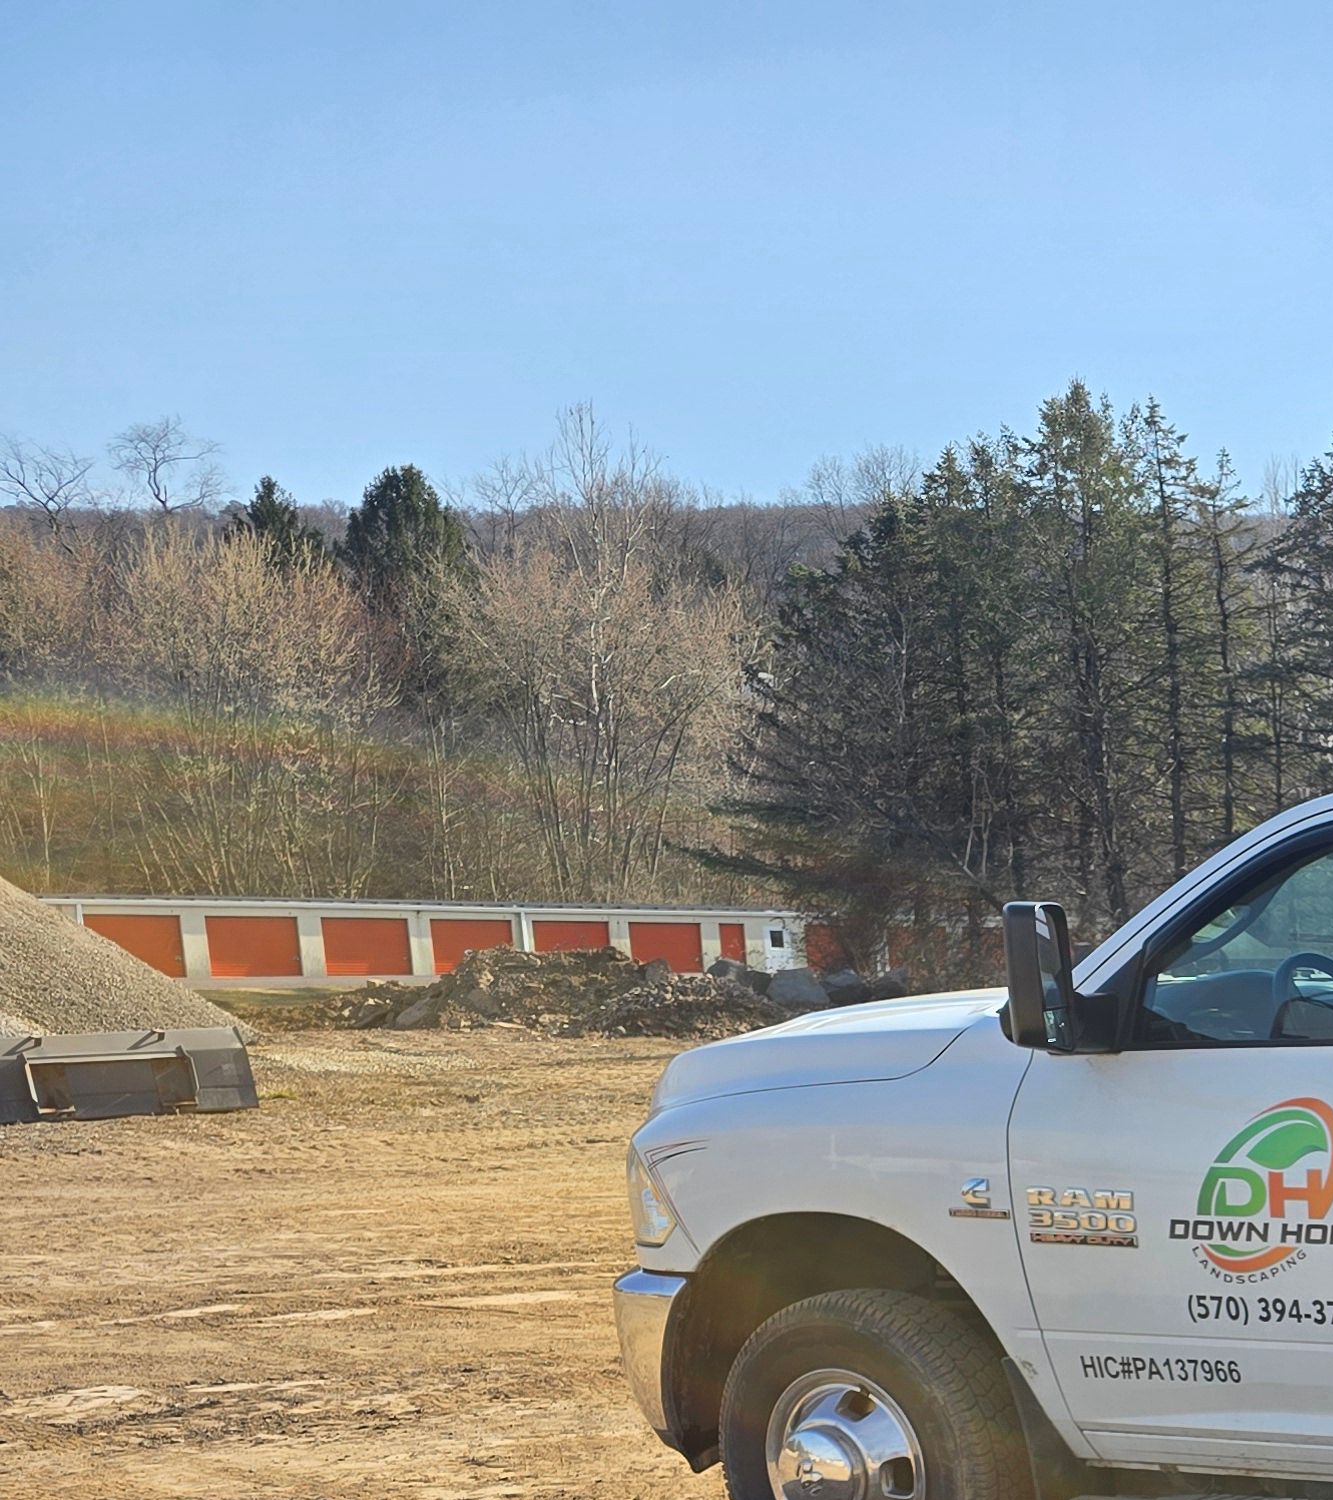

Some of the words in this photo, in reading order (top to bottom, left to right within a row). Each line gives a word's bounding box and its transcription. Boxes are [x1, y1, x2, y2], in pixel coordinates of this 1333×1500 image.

[1025, 1185, 1135, 1211] RAM
[1196, 1166, 1327, 1220] DH
[1028, 1208, 1137, 1233] 3500
[1169, 1219, 1270, 1243] DOWN
[1032, 1233, 1086, 1245] HEAVY
[1087, 1235, 1132, 1246] DUTY
[1192, 1246, 1307, 1284] LANDSCAPING
[1187, 1294, 1249, 1325] (570)
[1080, 1355, 1242, 1383] HIC#PA137966
